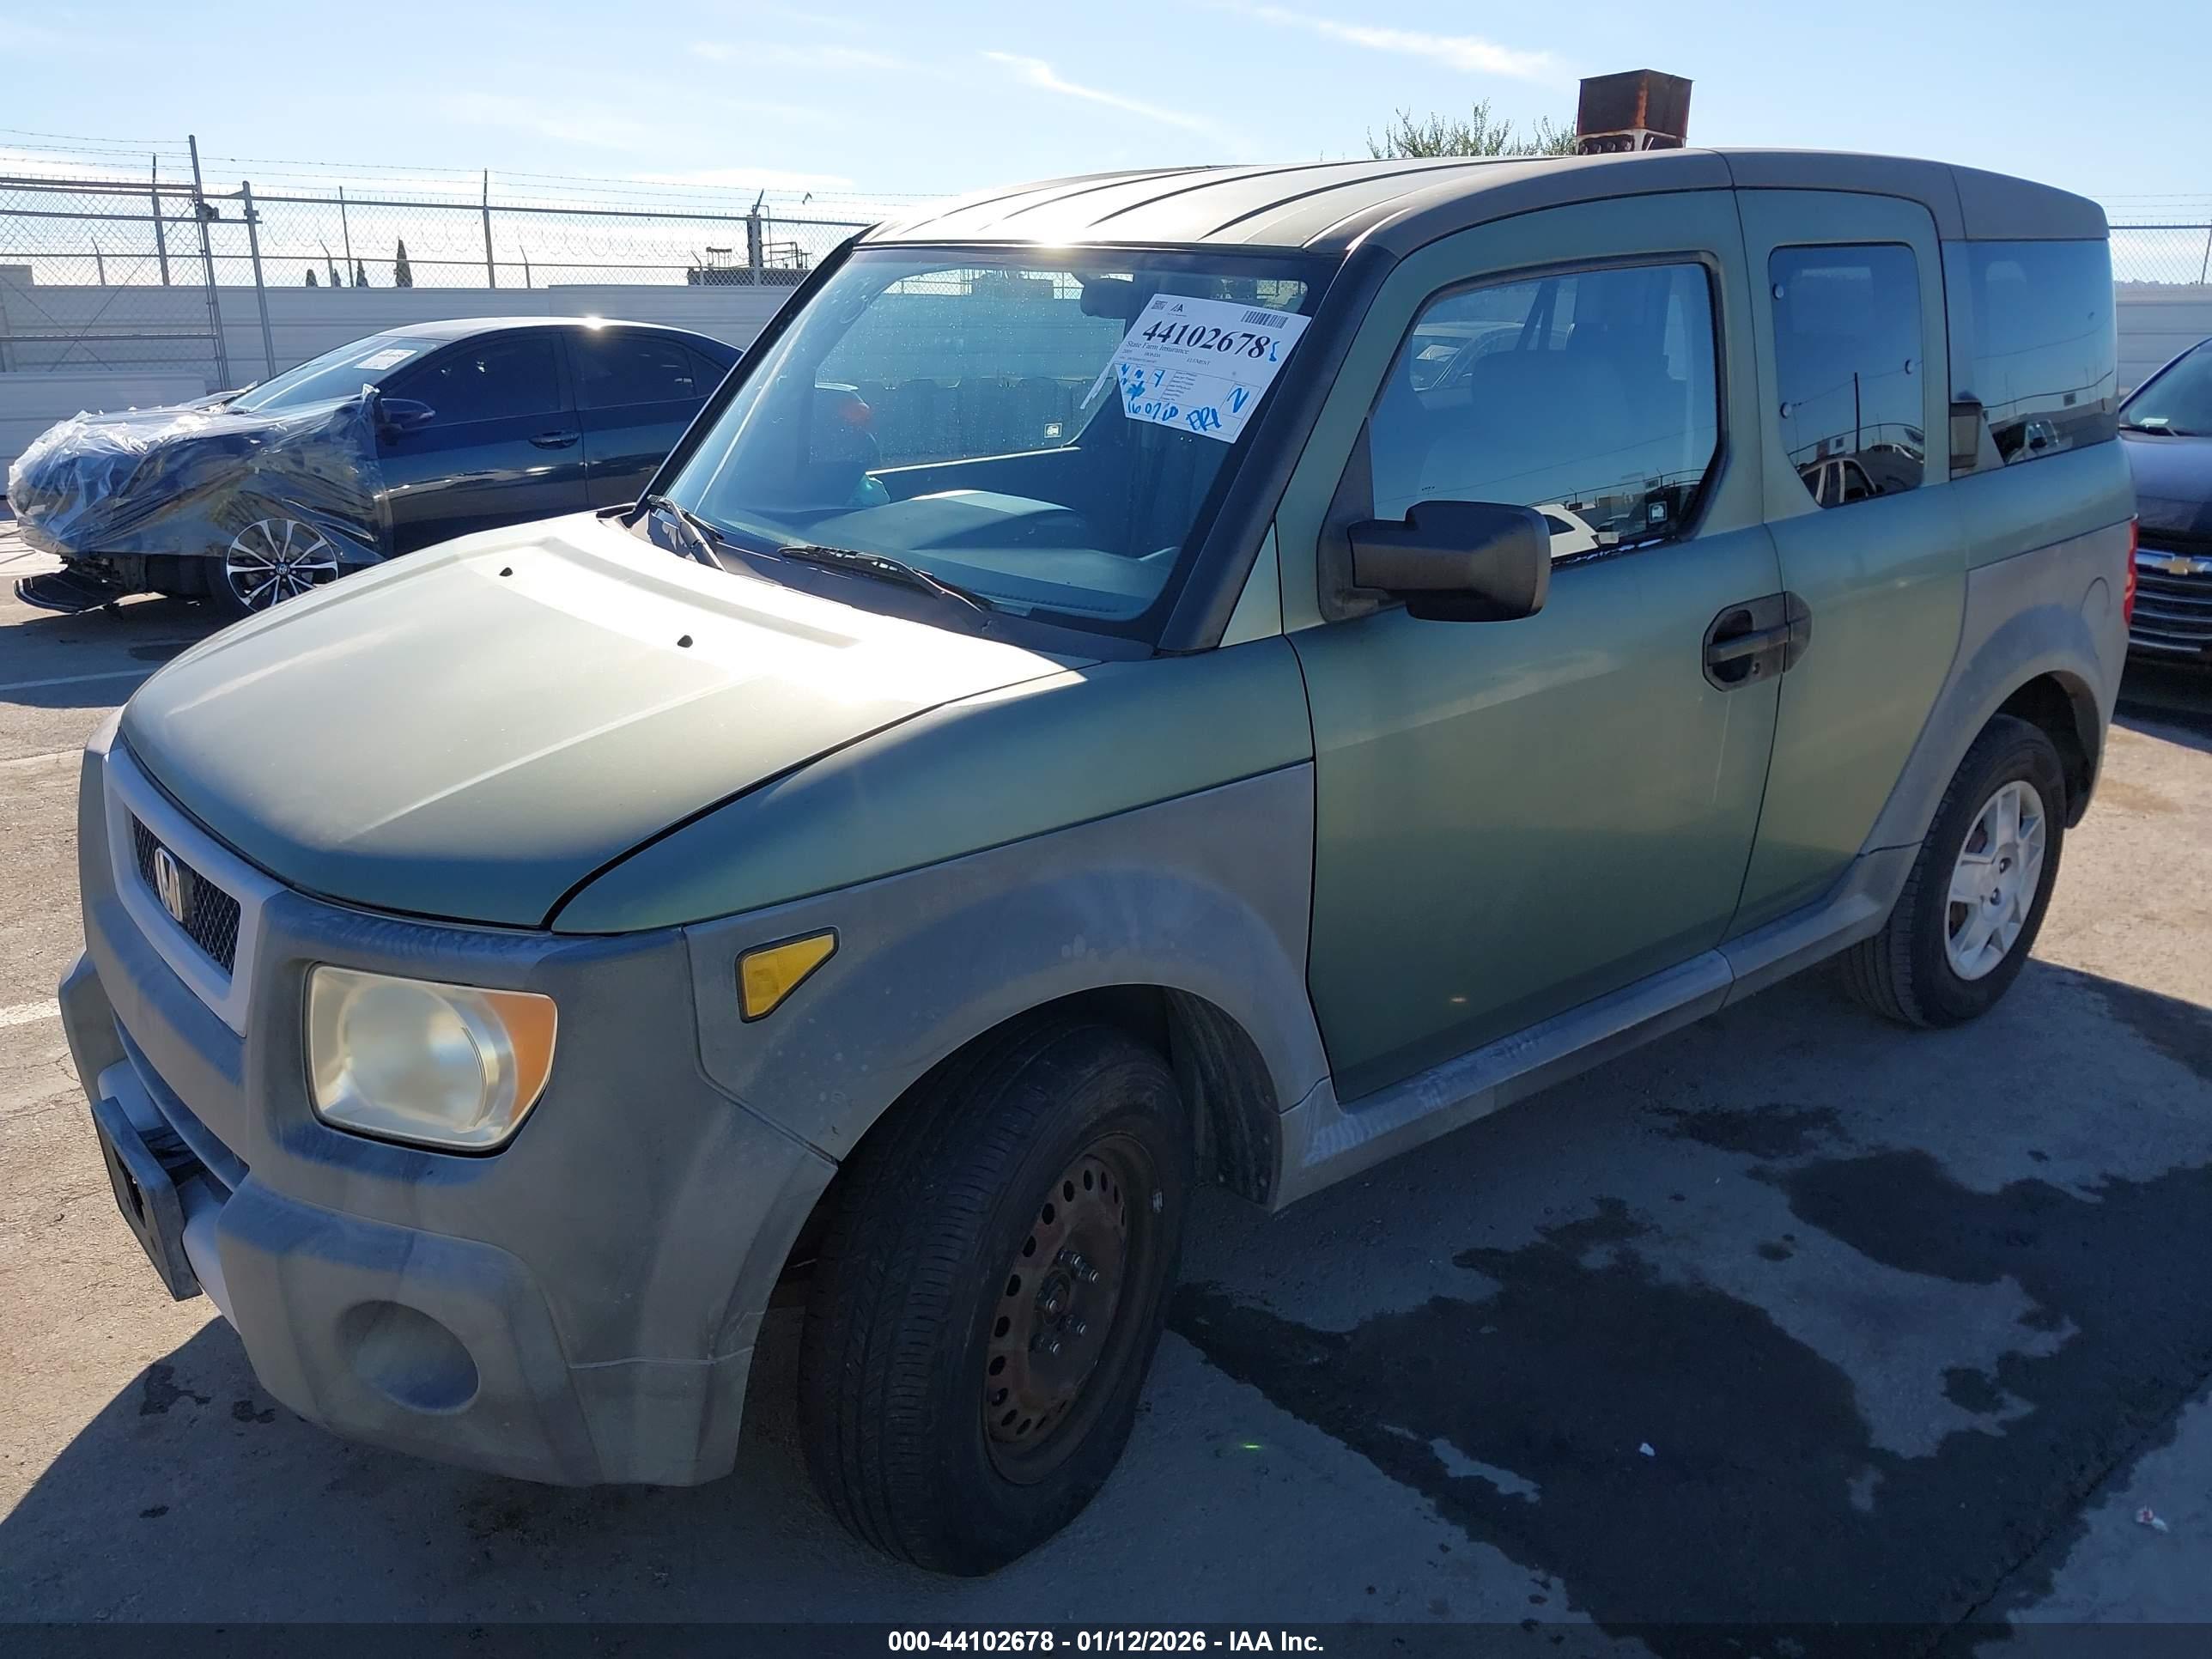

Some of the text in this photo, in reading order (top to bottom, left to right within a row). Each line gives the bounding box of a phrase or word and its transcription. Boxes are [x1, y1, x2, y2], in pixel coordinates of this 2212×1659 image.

[1126, 340, 1190, 355] State Farm Insurance
[1142, 320, 1271, 359] 44102678
